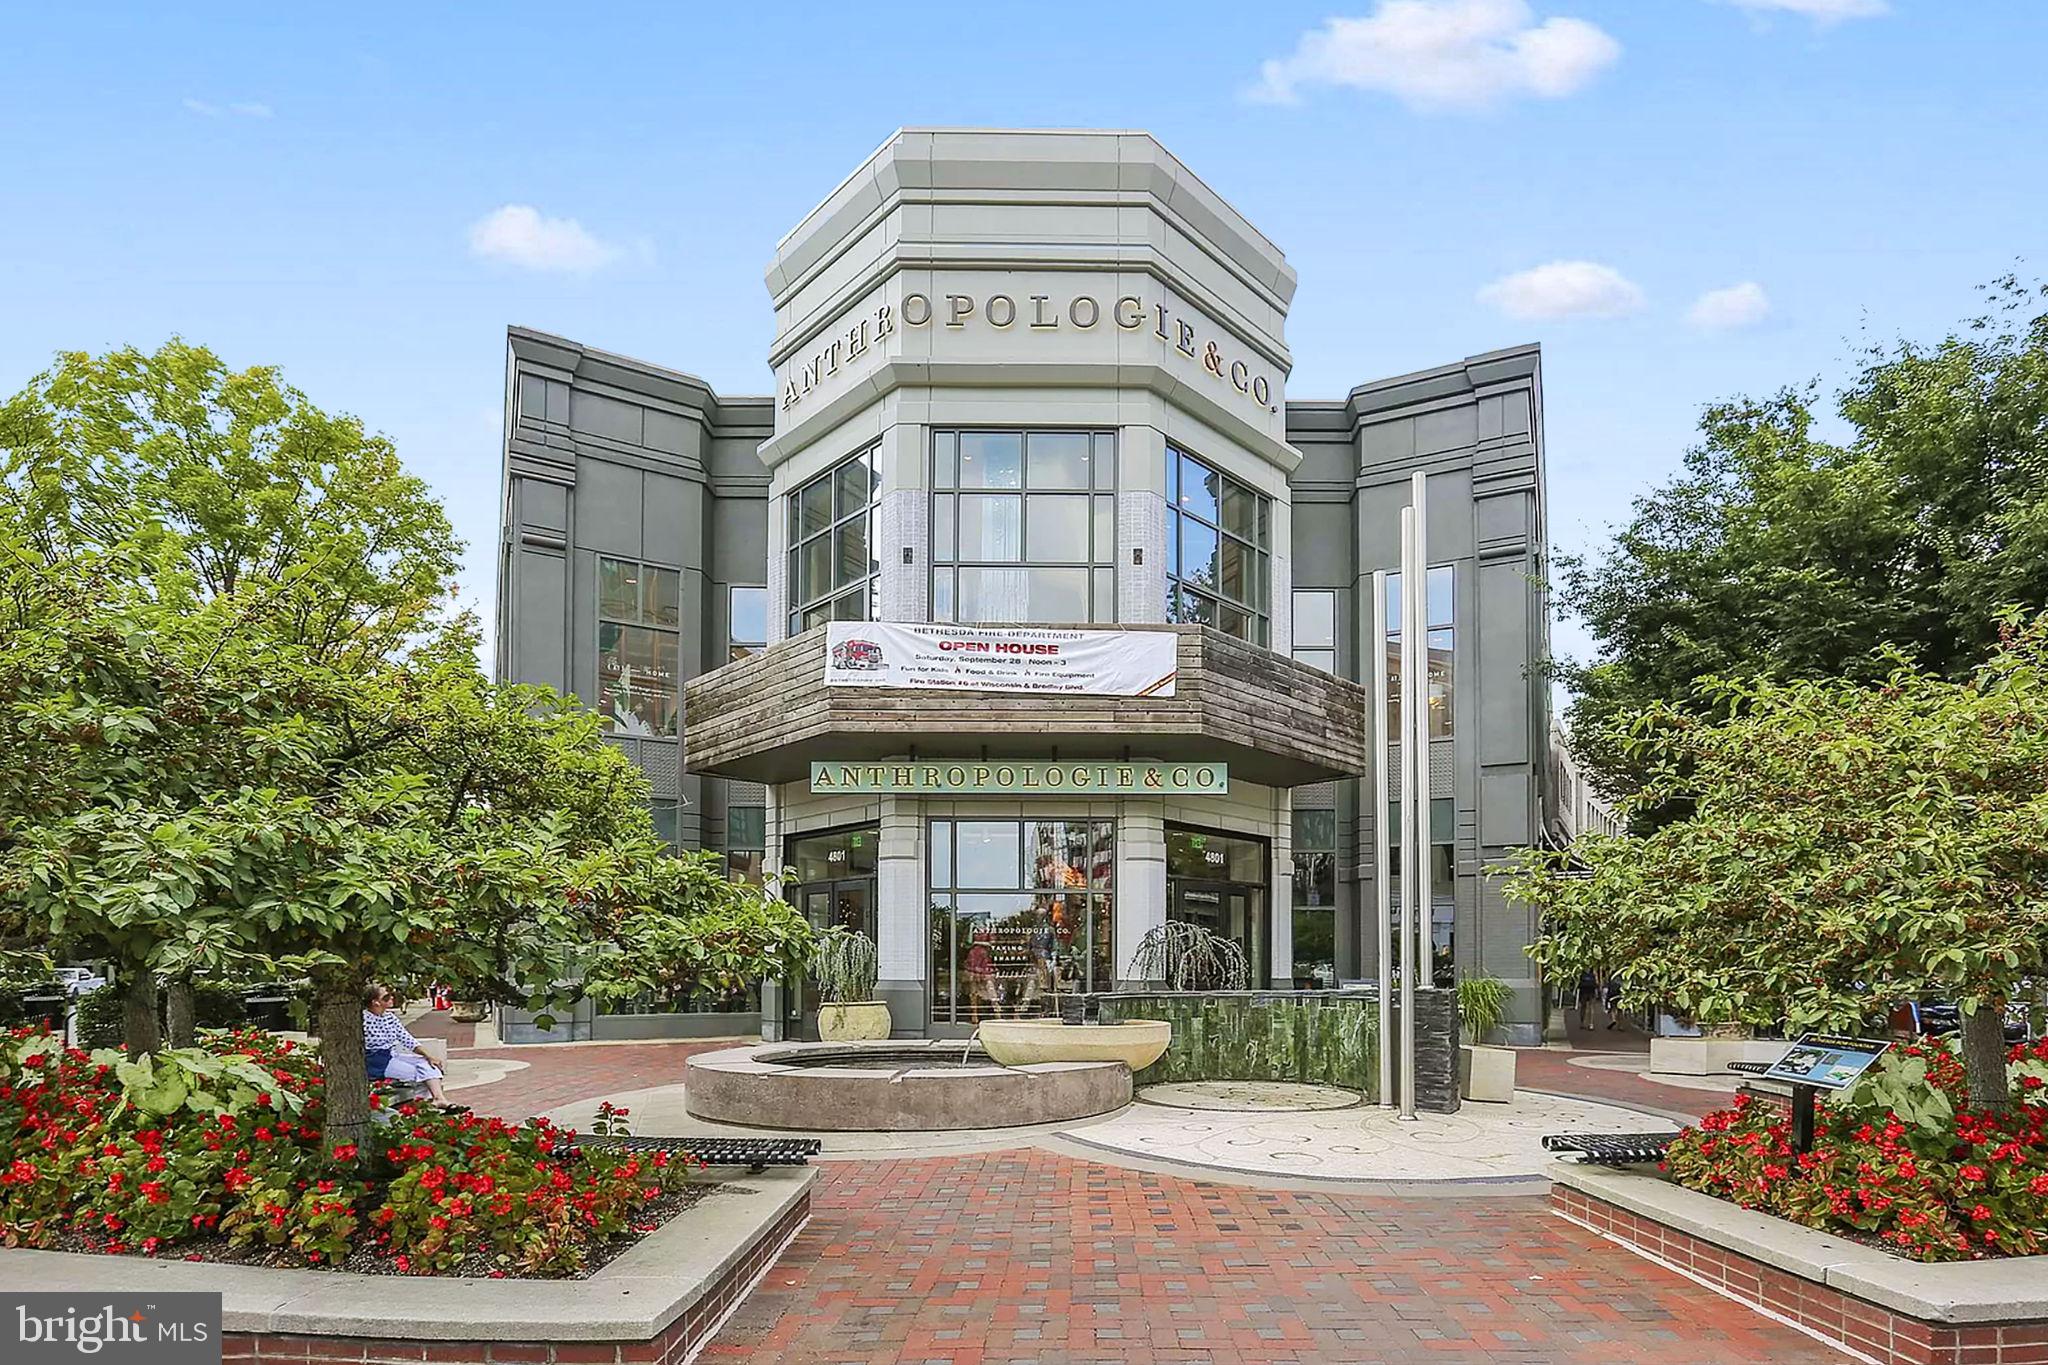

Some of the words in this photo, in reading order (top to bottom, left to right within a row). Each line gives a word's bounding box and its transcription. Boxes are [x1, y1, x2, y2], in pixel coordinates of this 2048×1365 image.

[914, 627, 975, 637] BETHESDA
[1007, 631, 1085, 640] DEPARTMENT
[938, 641, 990, 652] OPEN
[995, 643, 1060, 655] HOUSE
[958, 655, 1007, 665] September
[1028, 658, 1053, 666] Noon
[981, 680, 1023, 689] Wisconsin
[827, 849, 846, 862] 4801
[1204, 851, 1225, 864] 4801
